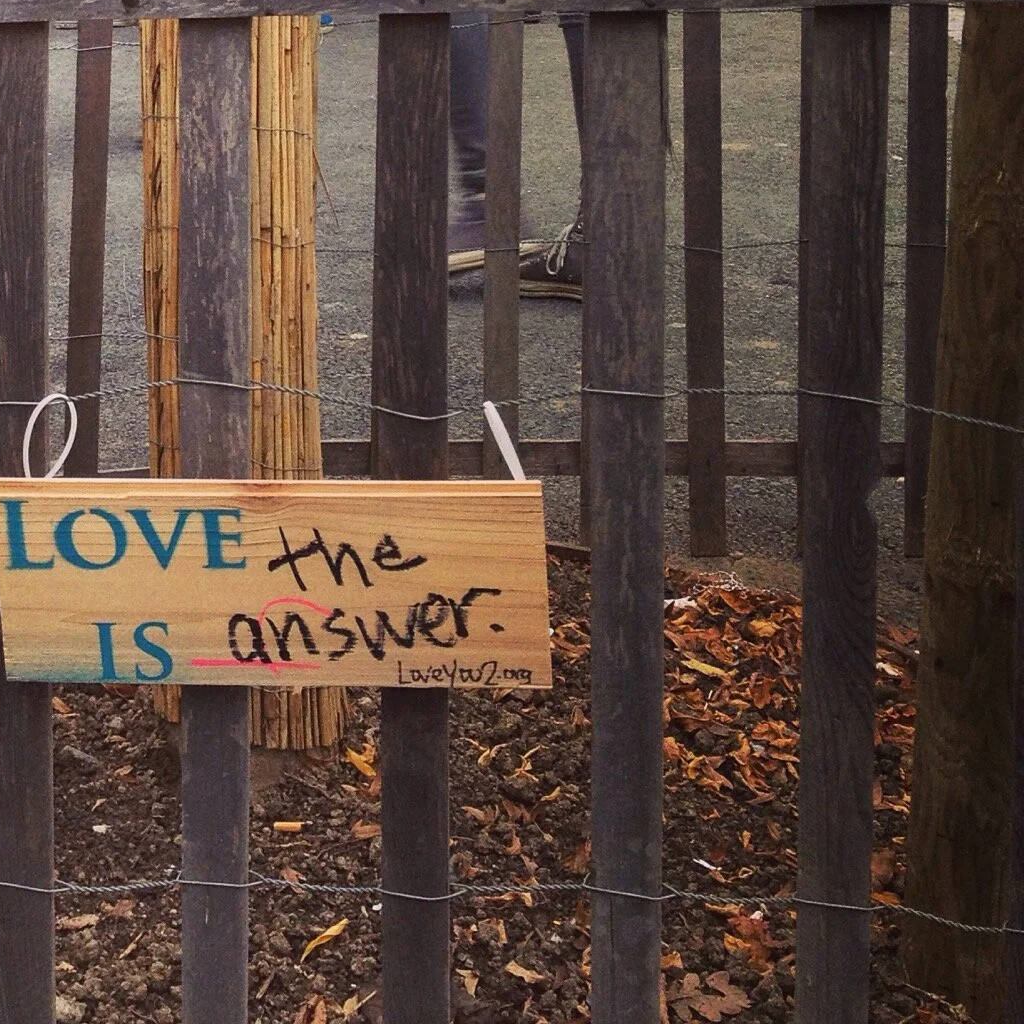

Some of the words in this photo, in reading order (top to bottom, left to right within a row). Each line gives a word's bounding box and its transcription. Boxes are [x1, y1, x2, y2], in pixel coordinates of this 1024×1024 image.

[0, 499, 248, 571] LOVE
[268, 525, 428, 591] the
[91, 620, 174, 682] IS
[228, 587, 506, 664] answer.
